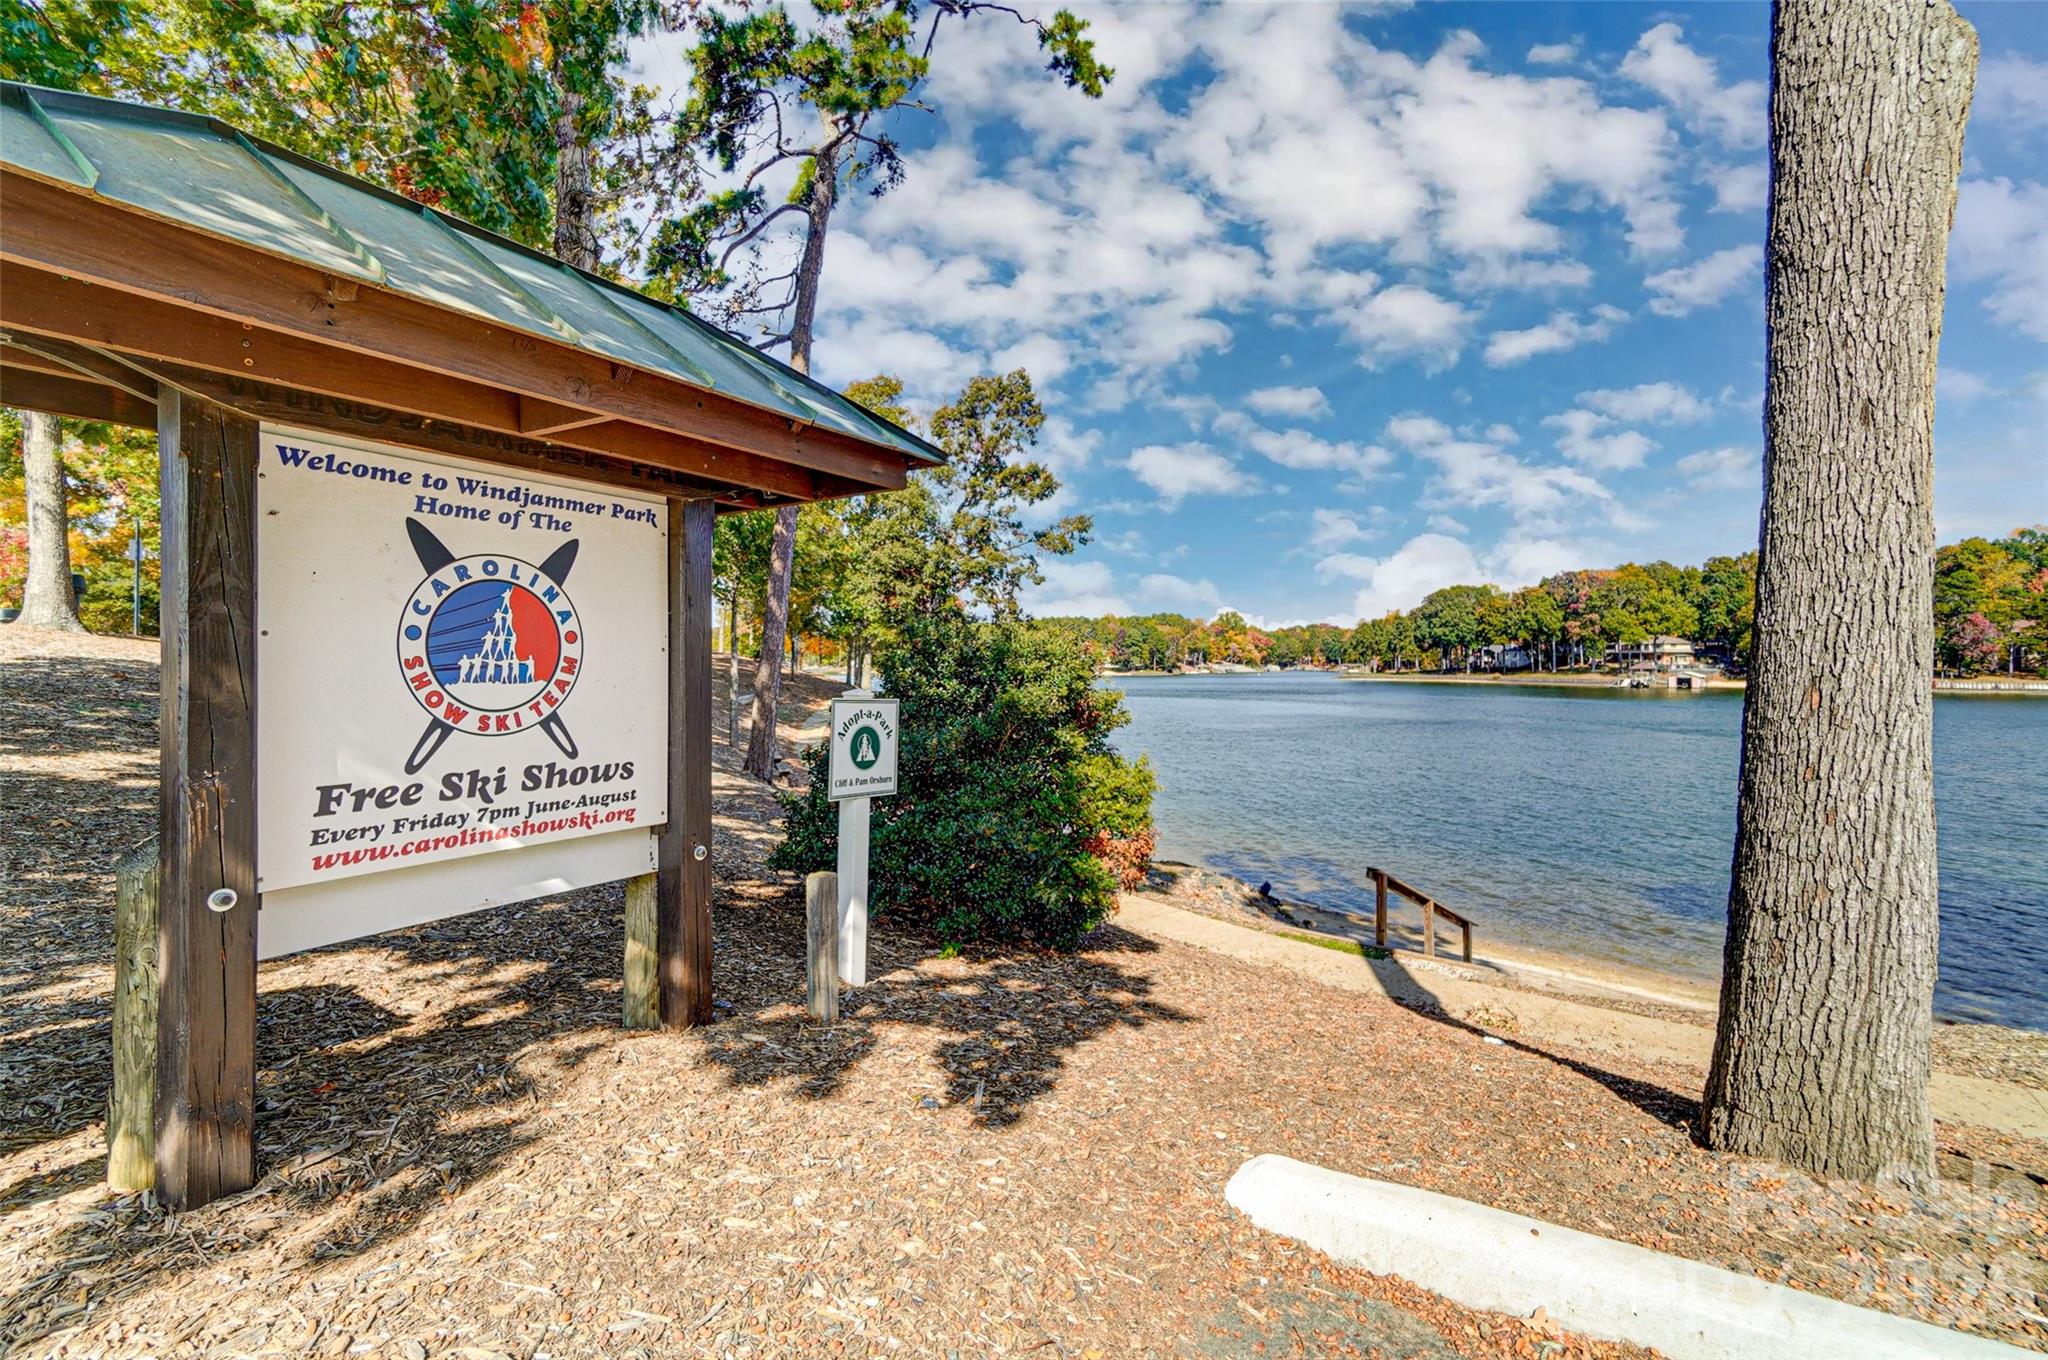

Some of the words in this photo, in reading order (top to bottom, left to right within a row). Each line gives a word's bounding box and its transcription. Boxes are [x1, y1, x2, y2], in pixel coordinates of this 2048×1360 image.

[276, 444, 412, 486] Welcome
[422, 473, 448, 491] to
[457, 476, 606, 516] Windjammer
[611, 503, 658, 529] Park
[414, 495, 491, 522] Home
[498, 509, 526, 530] of
[529, 513, 573, 533] The
[412, 560, 573, 626] CAROLINA
[404, 655, 469, 725] SHOW
[477, 712, 523, 732] SKI
[529, 656, 578, 718] TEAM
[837, 709, 893, 741] Adopt-a-Park
[313, 783, 423, 818] Free
[438, 766, 507, 804] Ski
[521, 761, 635, 792] Shows
[855, 777, 868, 786] Pam
[309, 822, 385, 847] Every
[392, 813, 470, 834] Friday
[476, 804, 520, 824] 7pm
[525, 788, 638, 819] June-August
[312, 806, 637, 871] www.carolinashowski.org
